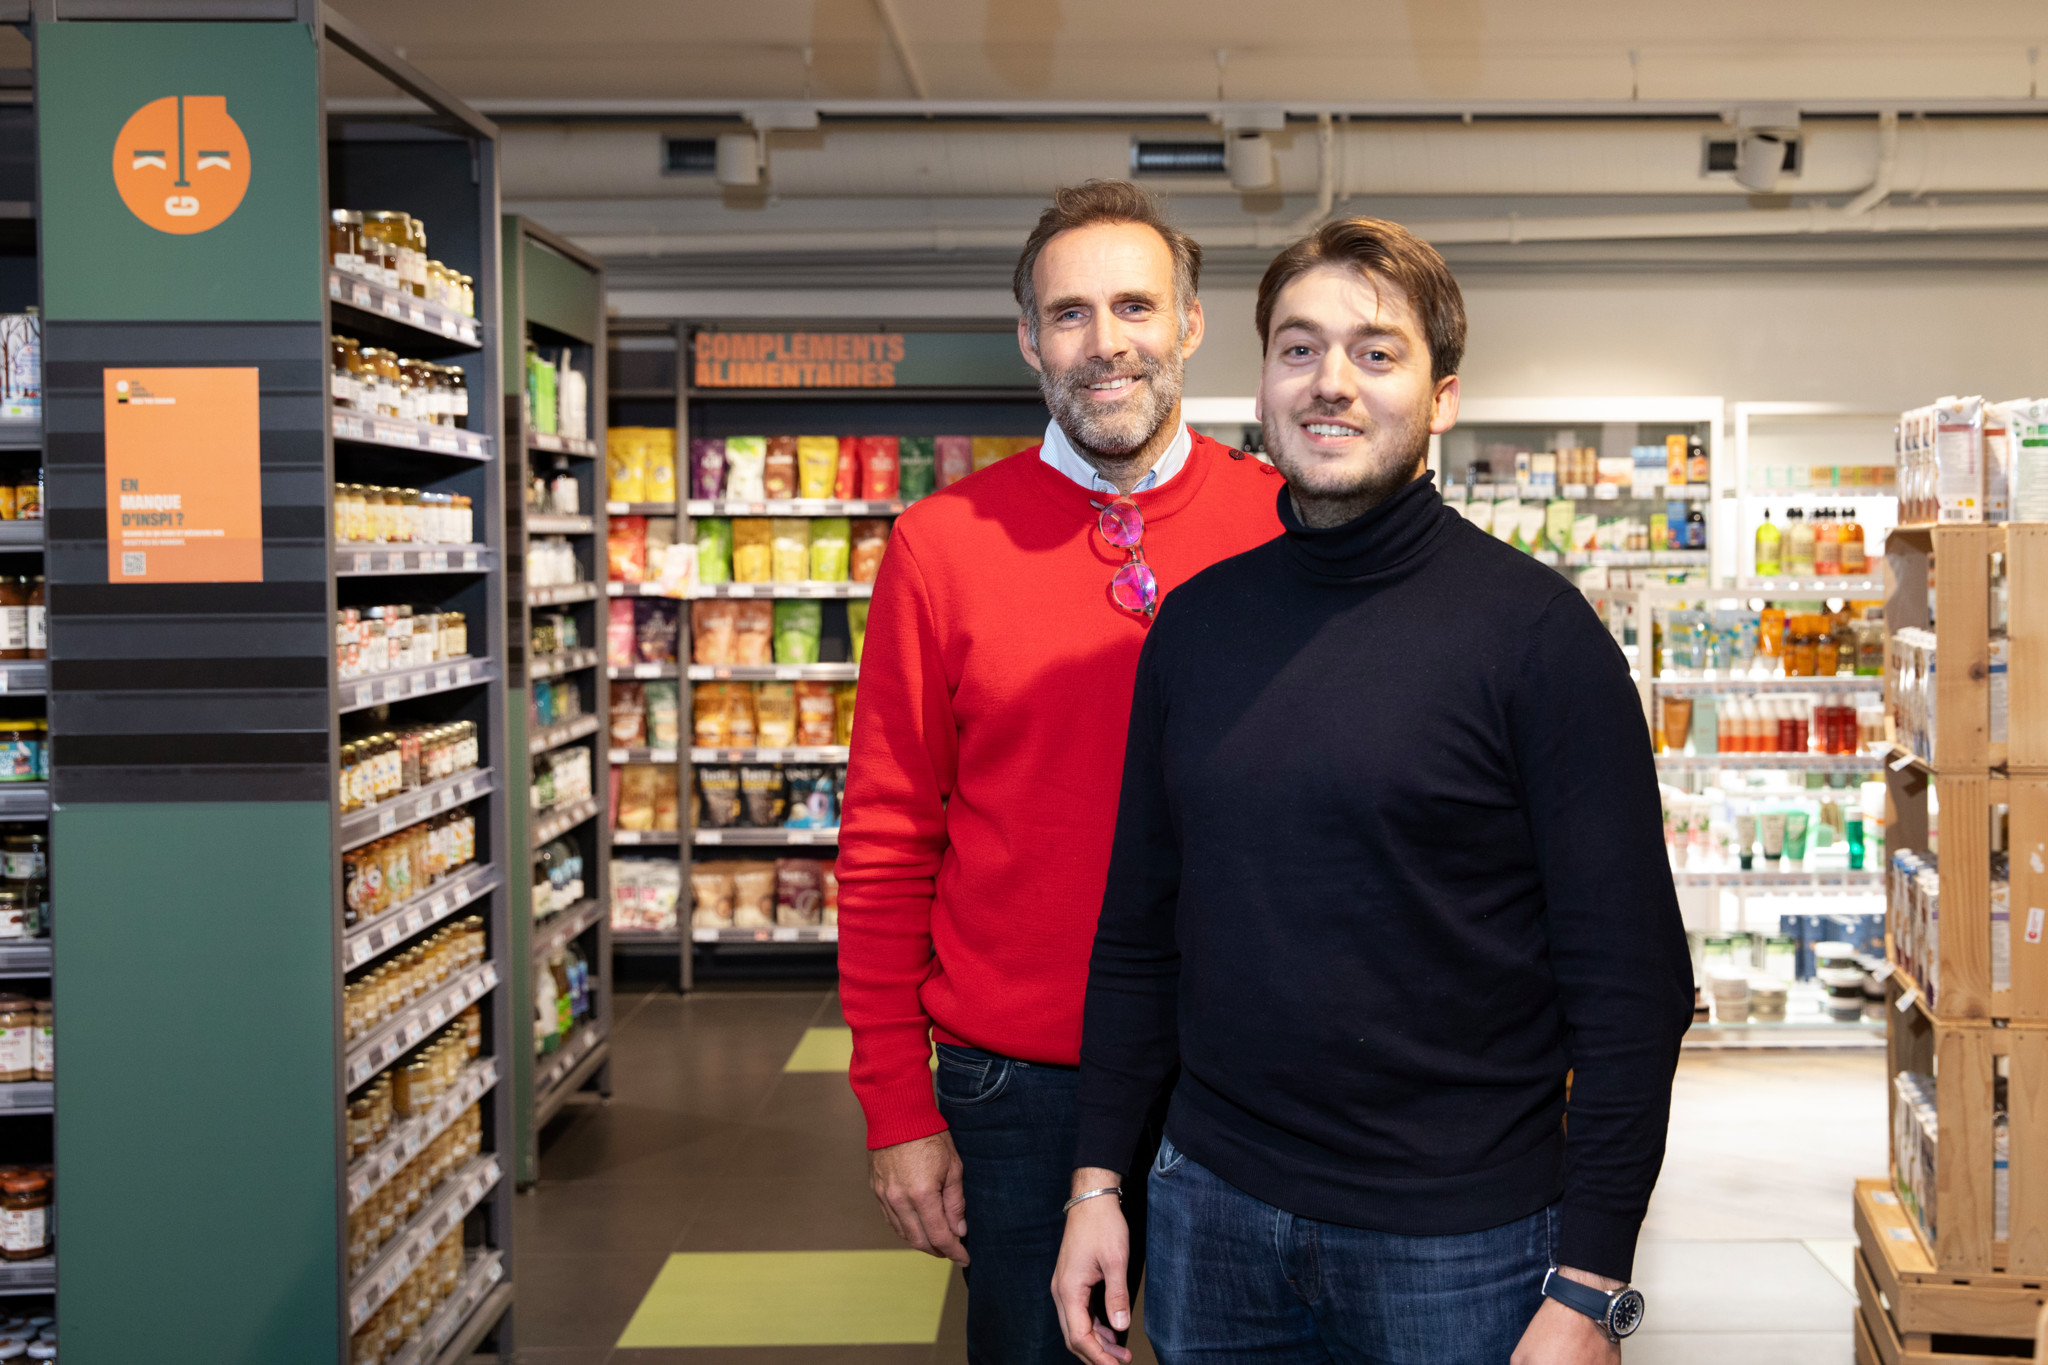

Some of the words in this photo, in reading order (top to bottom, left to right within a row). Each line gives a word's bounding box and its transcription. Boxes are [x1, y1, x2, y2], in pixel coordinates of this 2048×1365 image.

[695, 333, 905, 361] COMPLEMENTS
[695, 361, 896, 387] ALIMENTAIRES
[121, 478, 138, 492] EN
[120, 494, 181, 511] MANQUE
[122, 513, 172, 527] D'INSPI
[176, 512, 184, 526] ?
